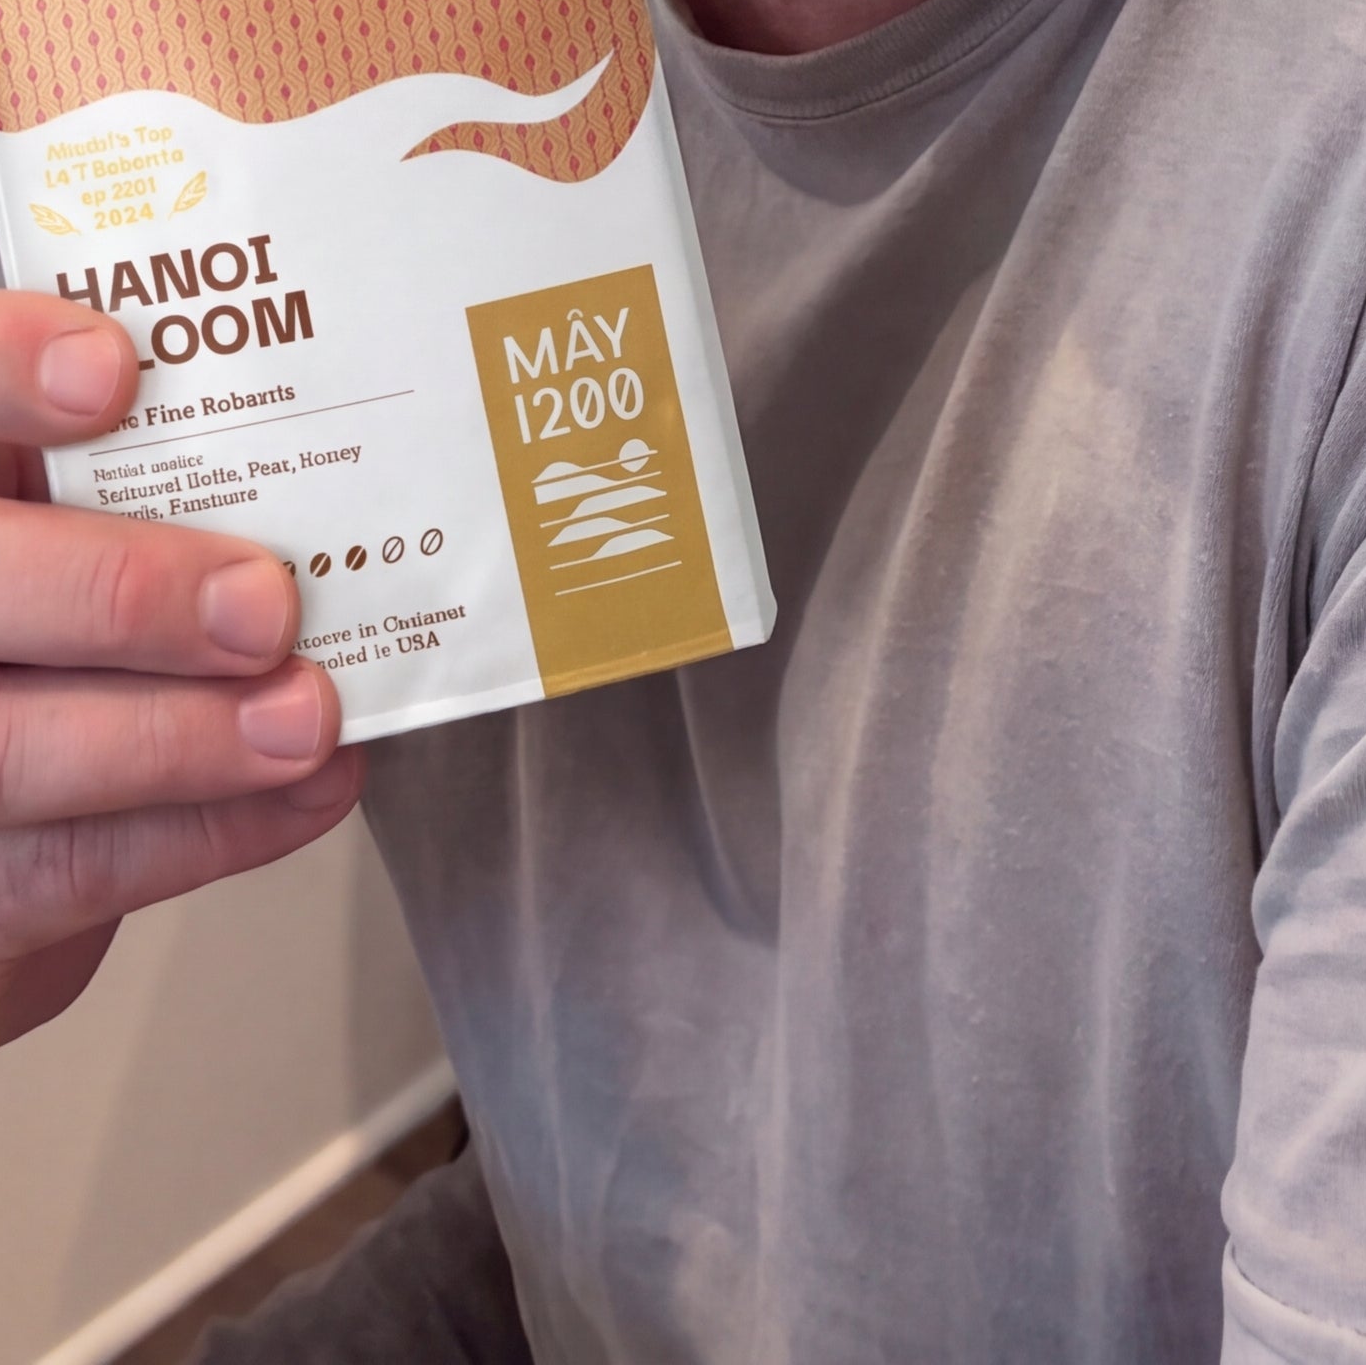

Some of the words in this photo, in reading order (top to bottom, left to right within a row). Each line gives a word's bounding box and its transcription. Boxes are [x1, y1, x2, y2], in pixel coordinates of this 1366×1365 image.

[134, 126, 172, 145] Top
[94, 202, 154, 230] 2024
[56, 234, 278, 313] HANOI
[502, 307, 630, 384] MÂY
[145, 404, 195, 427] Fine
[299, 445, 362, 469] Honey
[358, 623, 377, 639] in
[396, 630, 441, 654] USA
